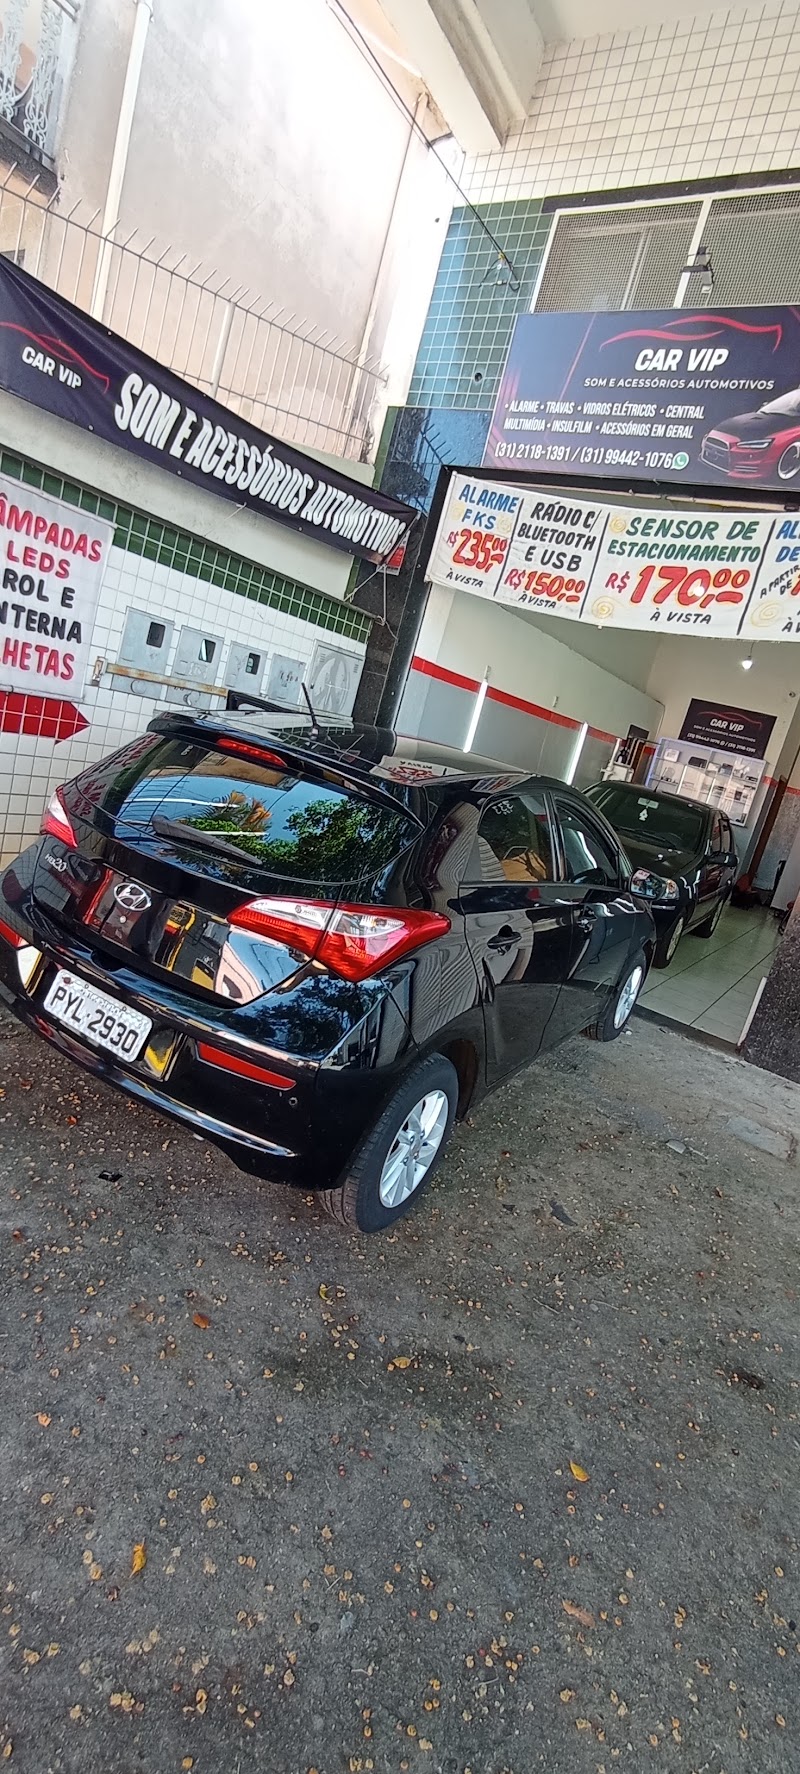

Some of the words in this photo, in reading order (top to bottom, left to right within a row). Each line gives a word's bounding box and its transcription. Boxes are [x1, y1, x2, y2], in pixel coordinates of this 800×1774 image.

[22, 346, 56, 376] CAR
[58, 364, 82, 388] VIP
[634, 348, 682, 372] CAR
[687, 348, 729, 372] VIP
[584, 378, 607, 387] SOM
[608, 378, 616, 387] E
[617, 376, 685, 388] ACESSÓRIOS
[687, 379, 774, 390] AUTOMOTIVOS
[509, 400, 540, 413] ALARME
[545, 402, 575, 414] TRAVAS
[583, 402, 611, 416] VIDROS
[612, 401, 657, 417] ELÉTRICOS
[665, 405, 705, 419] CENTRAL
[504, 417, 546, 431] MULTIMÍDIA
[551, 419, 593, 433] INSULFILM
[600, 421, 651, 436] ACESSÓRIOS
[651, 424, 666, 437] EM
[666, 425, 694, 438] GERAL
[114, 373, 181, 450] SOM
[169, 407, 197, 459] E
[184, 416, 314, 515] ACESSÓRIOS
[300, 480, 406, 555] AUTOMOTIVOS
[495, 441, 516, 458] (31)
[516, 444, 571, 461] 2118-1391
[580, 447, 604, 464] (31)
[604, 448, 674, 469] 99442-1076
[459, 484, 519, 513] ALARME
[462, 508, 496, 529] FKS
[530, 501, 582, 526] RÁDIO
[583, 509, 602, 533] C/
[446, 531, 459, 547] R$
[517, 523, 597, 551] BLUETOOTH
[626, 517, 719, 540] SENSOR
[726, 521, 759, 540] DE
[776, 520, 800, 539] AL
[6, 540, 70, 579] LEDS
[525, 546, 536, 562] E
[540, 549, 582, 572] USB
[607, 540, 760, 562] ESTACIONAMENTO
[2, 568, 50, 602] ROL
[61, 587, 75, 608] E
[455, 573, 484, 588] VISTA
[504, 568, 526, 590] R$
[605, 571, 630, 593] R$
[760, 588, 767, 599] A
[780, 579, 793, 596] DE
[528, 595, 557, 609] VISTA
[650, 608, 660, 622] À
[667, 612, 712, 624] VISTA
[0, 637, 74, 681] HETAS
[710, 718, 728, 729] CAR
[729, 722, 745, 732] VIP
[44, 854, 67, 872] HB20
